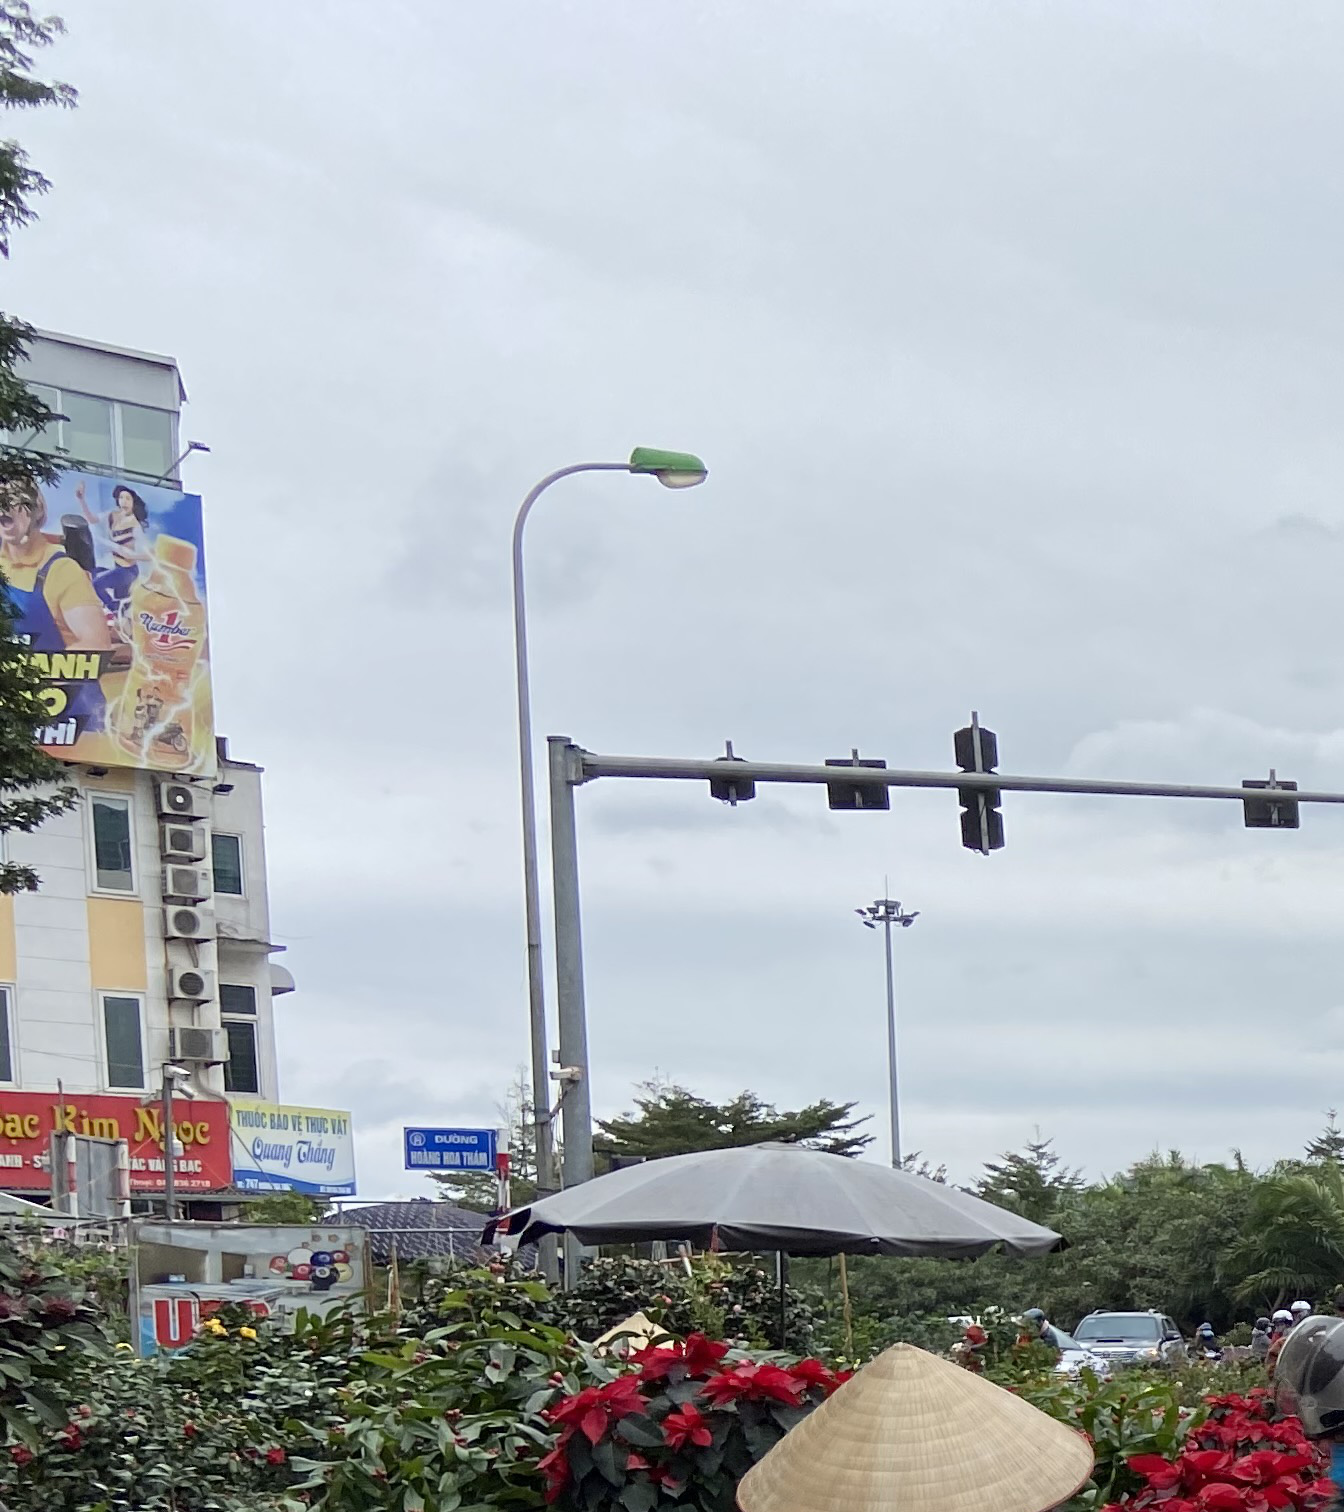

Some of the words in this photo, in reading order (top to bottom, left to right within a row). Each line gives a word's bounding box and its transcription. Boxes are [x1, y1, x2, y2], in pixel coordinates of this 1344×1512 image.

[51, 1104, 120, 1139] Kim
[235, 1104, 268, 1129] THUỐC
[291, 1111, 304, 1136] VỆ
[331, 1114, 348, 1139] VẬT
[179, 1159, 203, 1175] BẠC
[252, 1136, 293, 1169] Quang
[443, 1151, 461, 1166] HOA
[462, 1149, 488, 1166] THÁM
